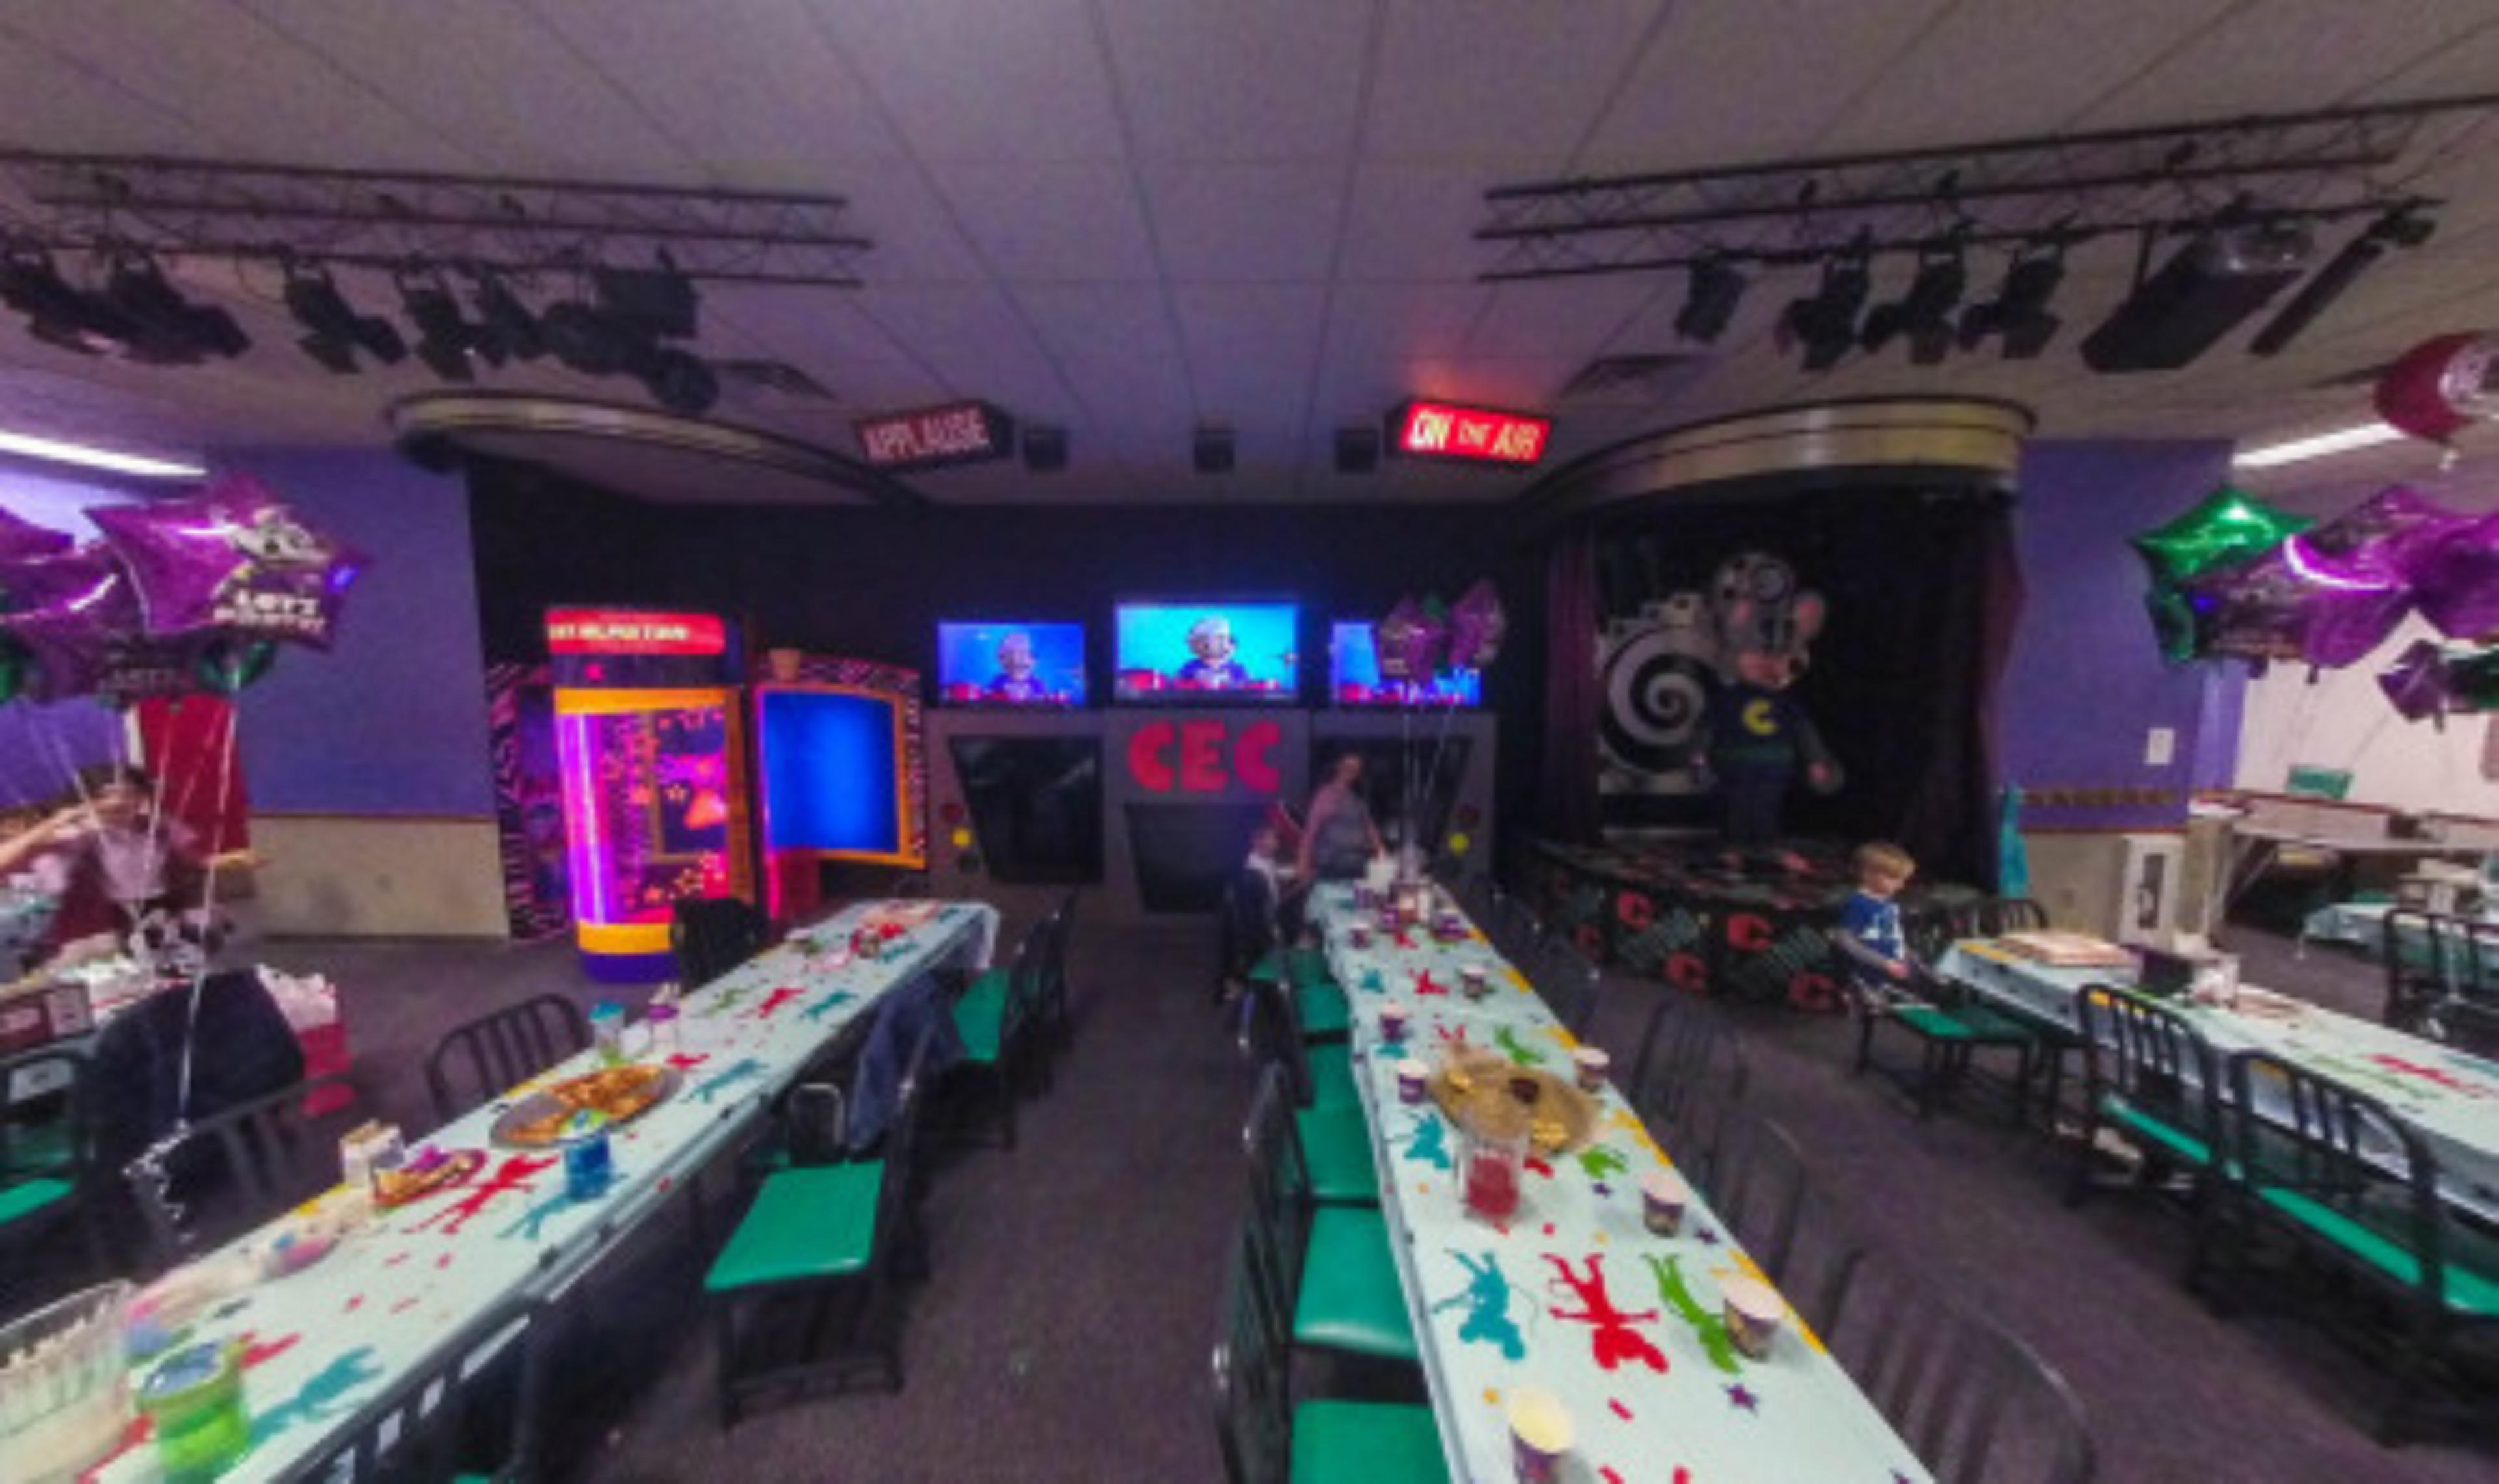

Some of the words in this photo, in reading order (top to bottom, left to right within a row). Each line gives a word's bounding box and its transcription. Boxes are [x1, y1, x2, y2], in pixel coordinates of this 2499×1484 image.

[863, 405, 989, 461] APPLAUSE
[1410, 411, 1454, 450] ON
[1490, 423, 1540, 459] AIR
[1743, 700, 1779, 735] C
[1128, 720, 1281, 792] CEC
